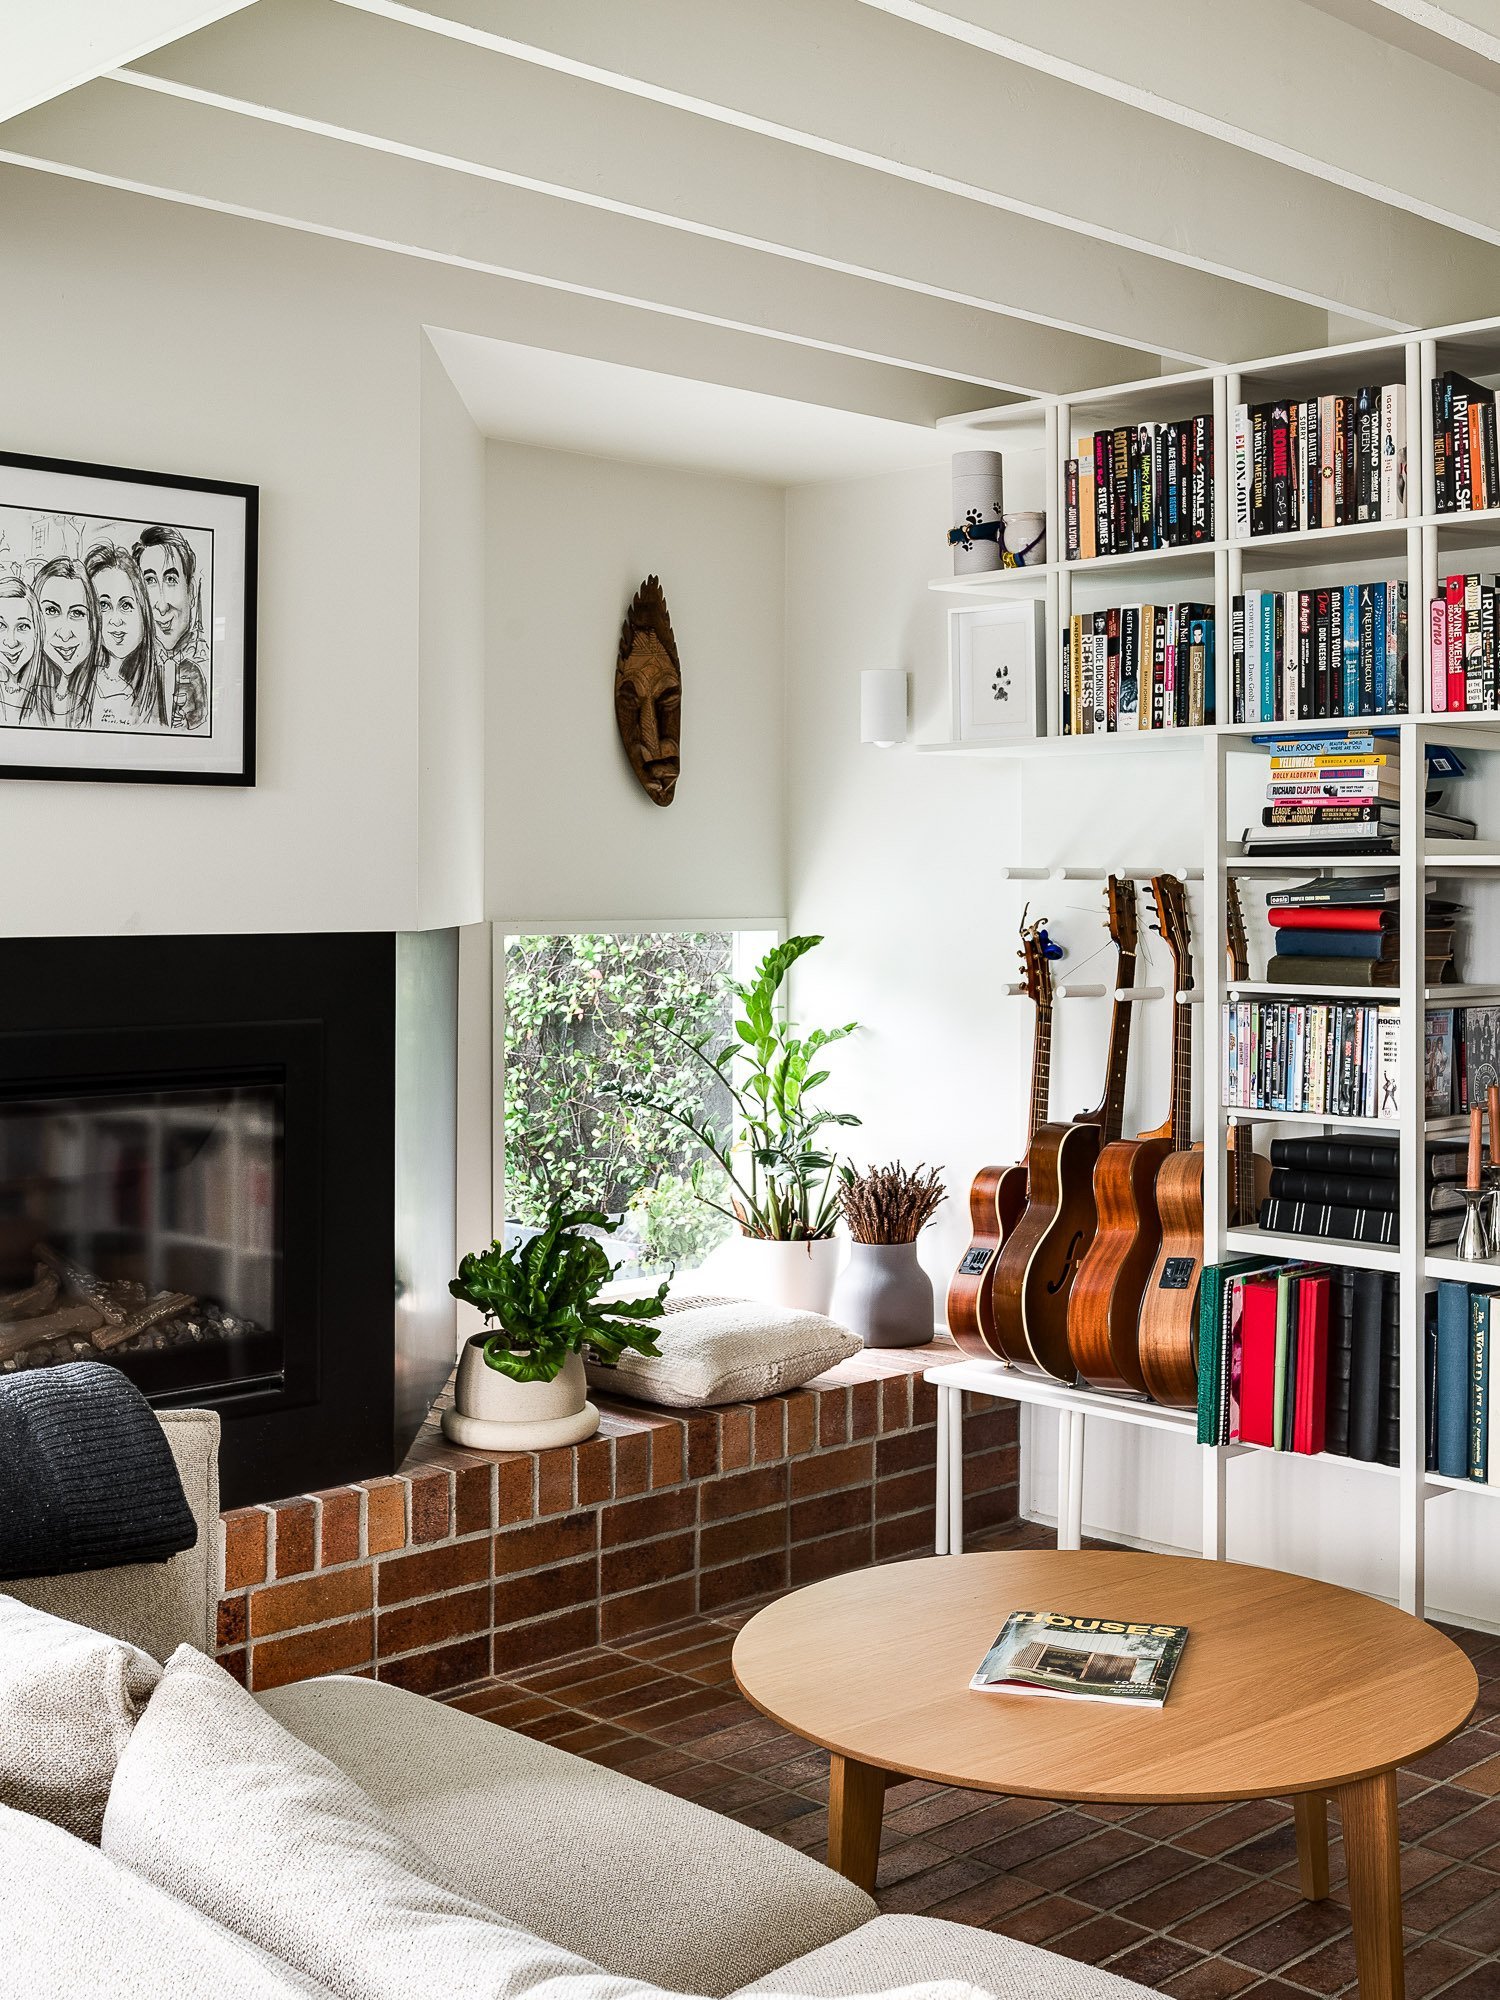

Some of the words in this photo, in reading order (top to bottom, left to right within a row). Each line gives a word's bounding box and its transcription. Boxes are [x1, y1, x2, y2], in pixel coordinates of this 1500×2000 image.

[1254, 414, 1262, 430] IAN
[1308, 404, 1317, 432] ROGER
[1453, 395, 1471, 450] IRVINE
[1196, 418, 1204, 456] PAUL
[1254, 432, 1262, 462] MOLLY
[1360, 414, 1370, 453] QUEEN
[1371, 411, 1379, 466] TOMMYLAND
[1434, 438, 1444, 456] NEIL
[1114, 430, 1128, 478] ROTTEN
[1168, 447, 1176, 460] ACE
[1236, 435, 1247, 481] ELTON
[1273, 428, 1287, 478] RONNIE
[1308, 434, 1317, 466] DALTREY
[1142, 455, 1152, 483] MARKY
[1169, 460, 1177, 484] FREHLEY
[1435, 456, 1445, 476] FINN
[1170, 486, 1177, 496] NO
[1196, 462, 1204, 528] STANLEY
[1254, 464, 1262, 508] MELDRUM
[1455, 454, 1472, 512] WELSH
[1098, 486, 1108, 514] STEVE
[1142, 485, 1152, 523] RAMONE
[1237, 483, 1248, 524] JOHN
[1069, 507, 1078, 526] JOHN
[1100, 516, 1109, 545] JONES
[1118, 512, 1126, 533] Lydon
[1069, 527, 1078, 549] LYDON
[1300, 594, 1310, 606] the
[1318, 592, 1329, 616] Doc
[1467, 576, 1478, 610] IRVINE
[1180, 606, 1189, 626] Vince
[1233, 611, 1244, 634] BILLY
[1300, 608, 1310, 632] Angels
[1332, 592, 1341, 636] MALCOLM
[1362, 606, 1373, 648] FREDDIE
[1433, 608, 1444, 646] Porno
[1454, 604, 1462, 636] IRVINE
[1467, 610, 1479, 646] WELSH
[1483, 593, 1494, 652] IRVINE
[1096, 637, 1104, 663] BRUCE
[1180, 628, 1189, 642] Neil
[1233, 636, 1244, 655] IDOL
[1318, 628, 1327, 642] DOC
[1125, 636, 1133, 676] RICHARDS
[1193, 652, 1202, 672] Feel
[1318, 643, 1327, 671] NEESON
[1332, 638, 1341, 668] YOUNG
[1434, 650, 1444, 674] IRVINE
[1454, 640, 1462, 673] WELSH
[1082, 634, 1094, 708] RECKLESS
[1096, 664, 1104, 707] DICKINSON
[1364, 650, 1373, 693] MERCURY
[1484, 654, 1495, 711] WELSH
[1434, 676, 1444, 701] WELSH
[1276, 744, 1295, 752] SALLY
[1296, 742, 1325, 751] ROONEY
[1272, 786, 1296, 795] RICHARD
[1296, 786, 1321, 794] CLAPTON
[1474, 1330, 1484, 1380] WORLD
[1474, 1384, 1484, 1424] ATLAS
[1015, 1613, 1178, 1638] HOUSES
